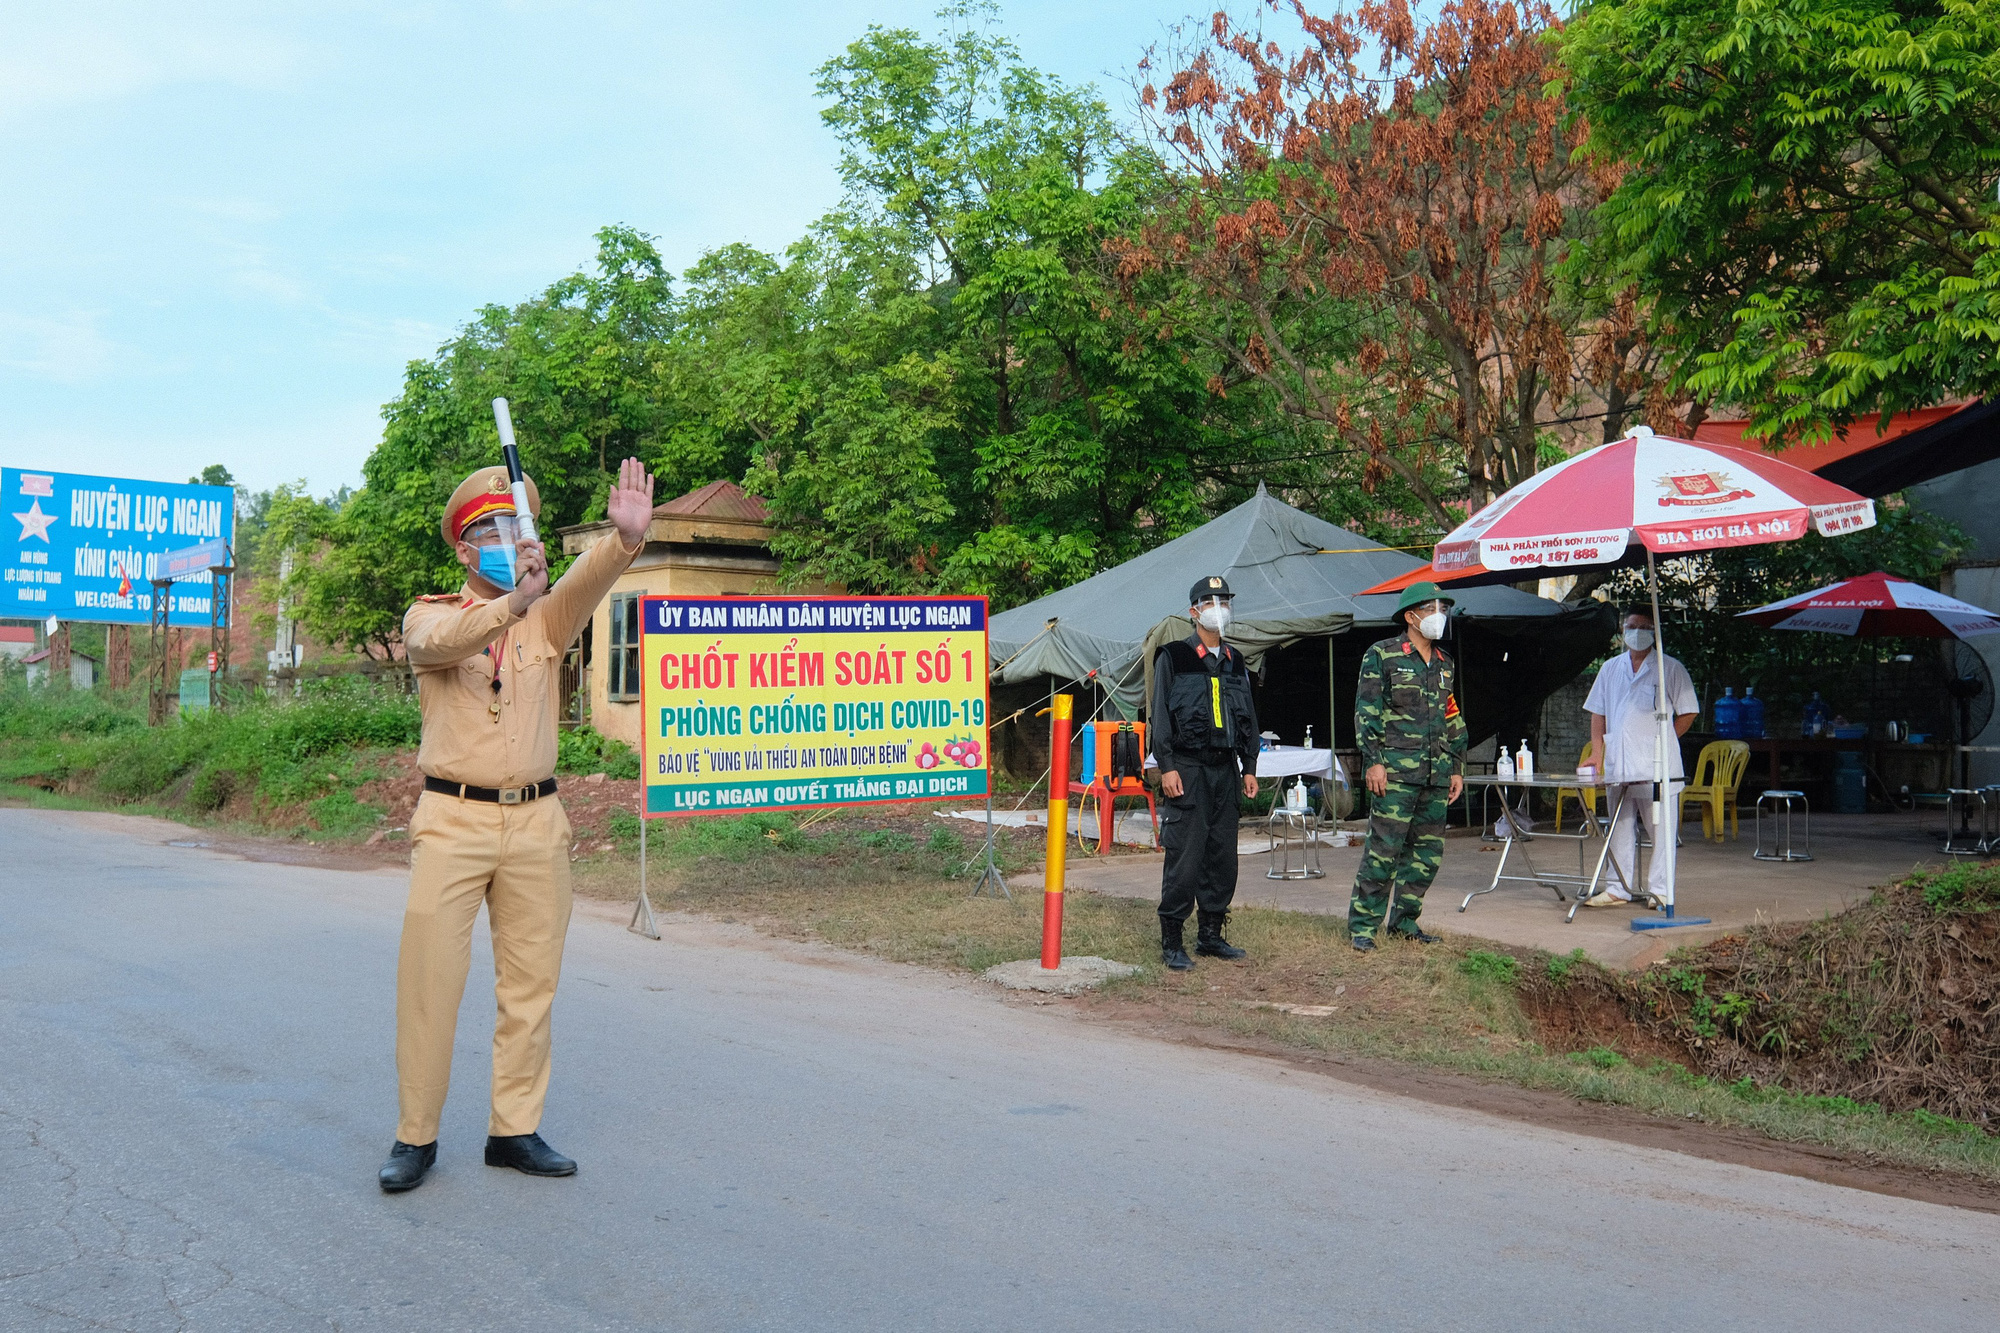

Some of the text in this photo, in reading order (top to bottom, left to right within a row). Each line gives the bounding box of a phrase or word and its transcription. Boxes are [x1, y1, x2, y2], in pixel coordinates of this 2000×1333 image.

[71, 484, 222, 544] HUYỆN LỤC NGẠN
[1683, 496, 1730, 505] HABECO
[1490, 534, 1620, 552] NHÀ PHÂN PHỐI SƠN HƯƠNG
[1656, 518, 1790, 545] BIA HƠI HÀ NỘI
[74, 541, 106, 577] KÍNH
[108, 545, 142, 581] CHÀO
[1510, 547, 1599, 565] 0984 187 888
[74, 590, 133, 610] WELCOME
[135, 594, 151, 611] TO
[178, 596, 211, 613] NGAN
[659, 600, 971, 630] ỦY BAN NHÂN DÂN HUYỆN LỤC NGẠN
[660, 637, 972, 690] CHỐT KIỂM SOÁT SỐ 1
[660, 694, 985, 737] PHÒNG CHỐNG DỊCH COVID-19
[659, 746, 682, 774] BẢO
[686, 748, 700, 777] VỆ
[744, 743, 763, 771] VẢI
[800, 748, 816, 768] AN
[819, 743, 847, 767] TOÀN
[851, 745, 875, 770] DỊCH
[674, 776, 968, 810] LỤC NGẠN QUYẾT THẮNG ĐẠI DỊCH
